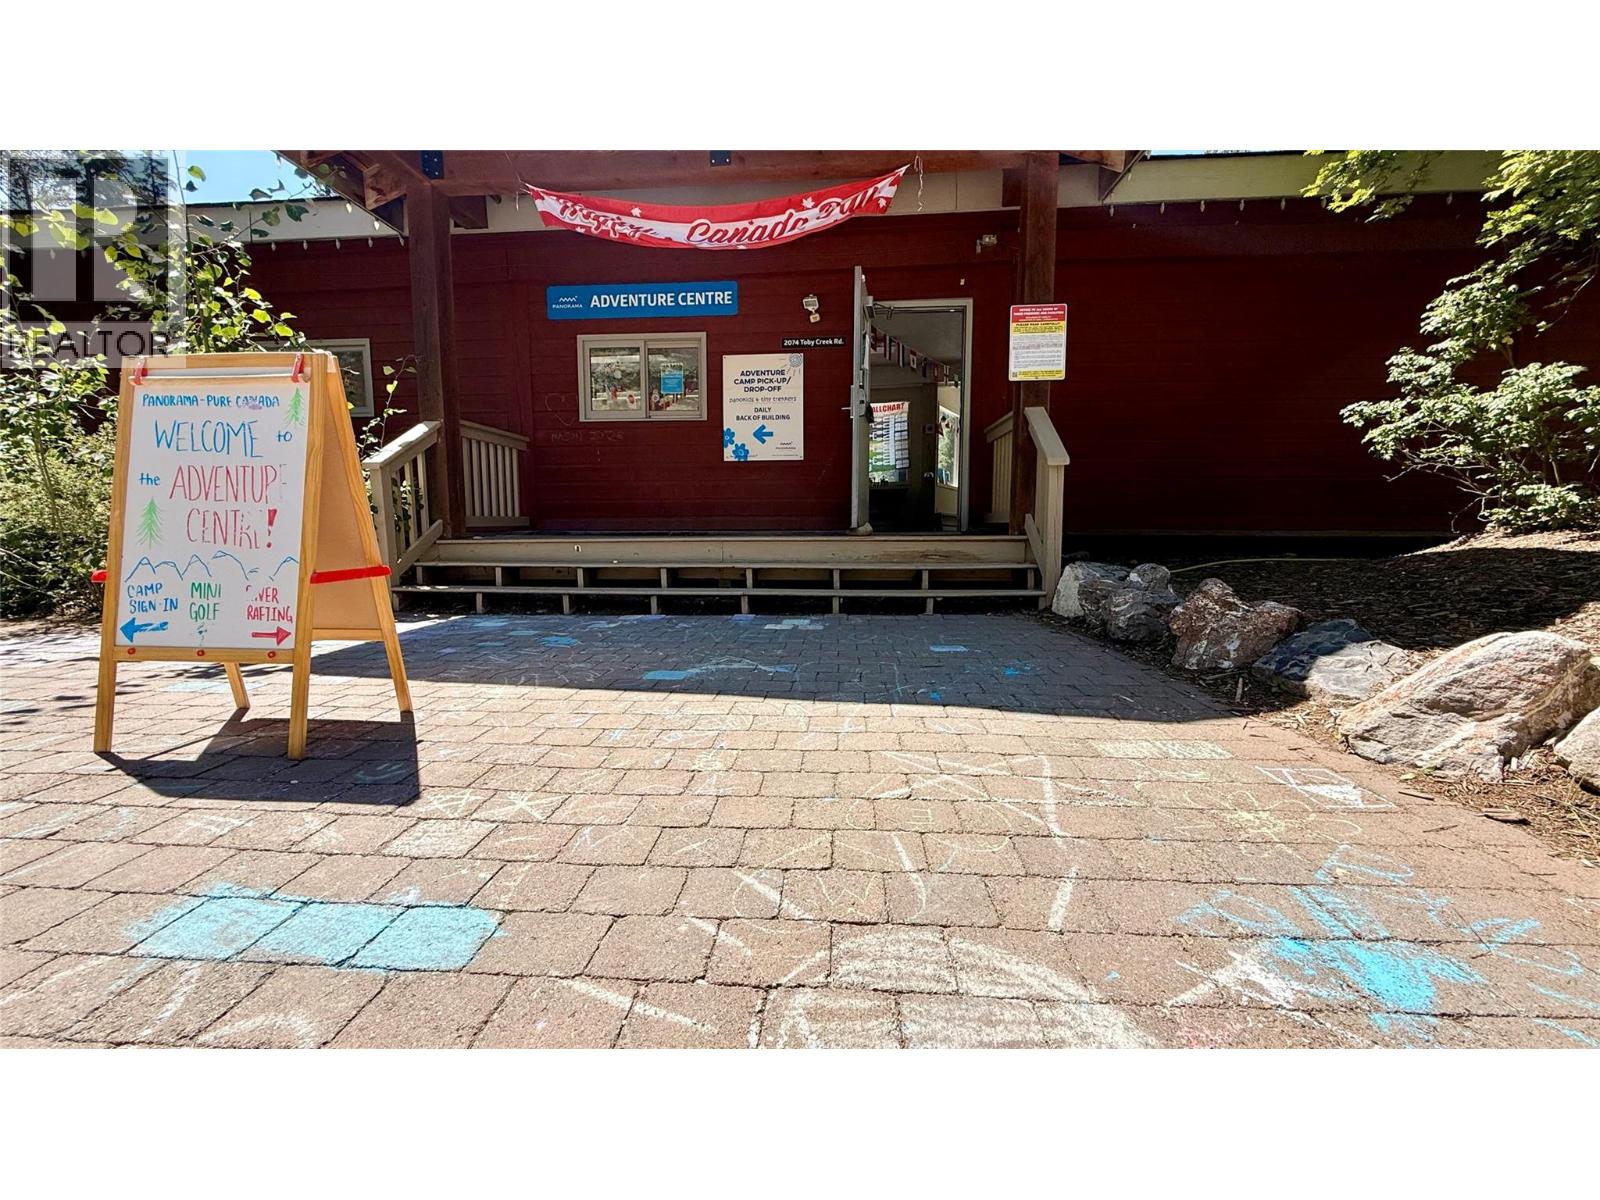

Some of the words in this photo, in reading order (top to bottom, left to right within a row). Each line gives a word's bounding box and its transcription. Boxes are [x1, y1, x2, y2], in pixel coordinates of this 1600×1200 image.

[590, 293, 676, 308] ADVENTURE
[677, 291, 733, 306] CENTRE
[800, 338, 815, 347] Toby
[834, 337, 844, 345] Rd.
[740, 369, 786, 377] ADVENTURE
[757, 376, 792, 385] PICK-UP/
[154, 419, 264, 458] WELCOME
[277, 430, 293, 442] to
[138, 472, 161, 486] the
[127, 582, 163, 598] CAMP
[190, 582, 222, 600] MINI
[245, 584, 279, 604] VER
[189, 602, 221, 622] GOLF
[247, 605, 294, 623] RAFTING
